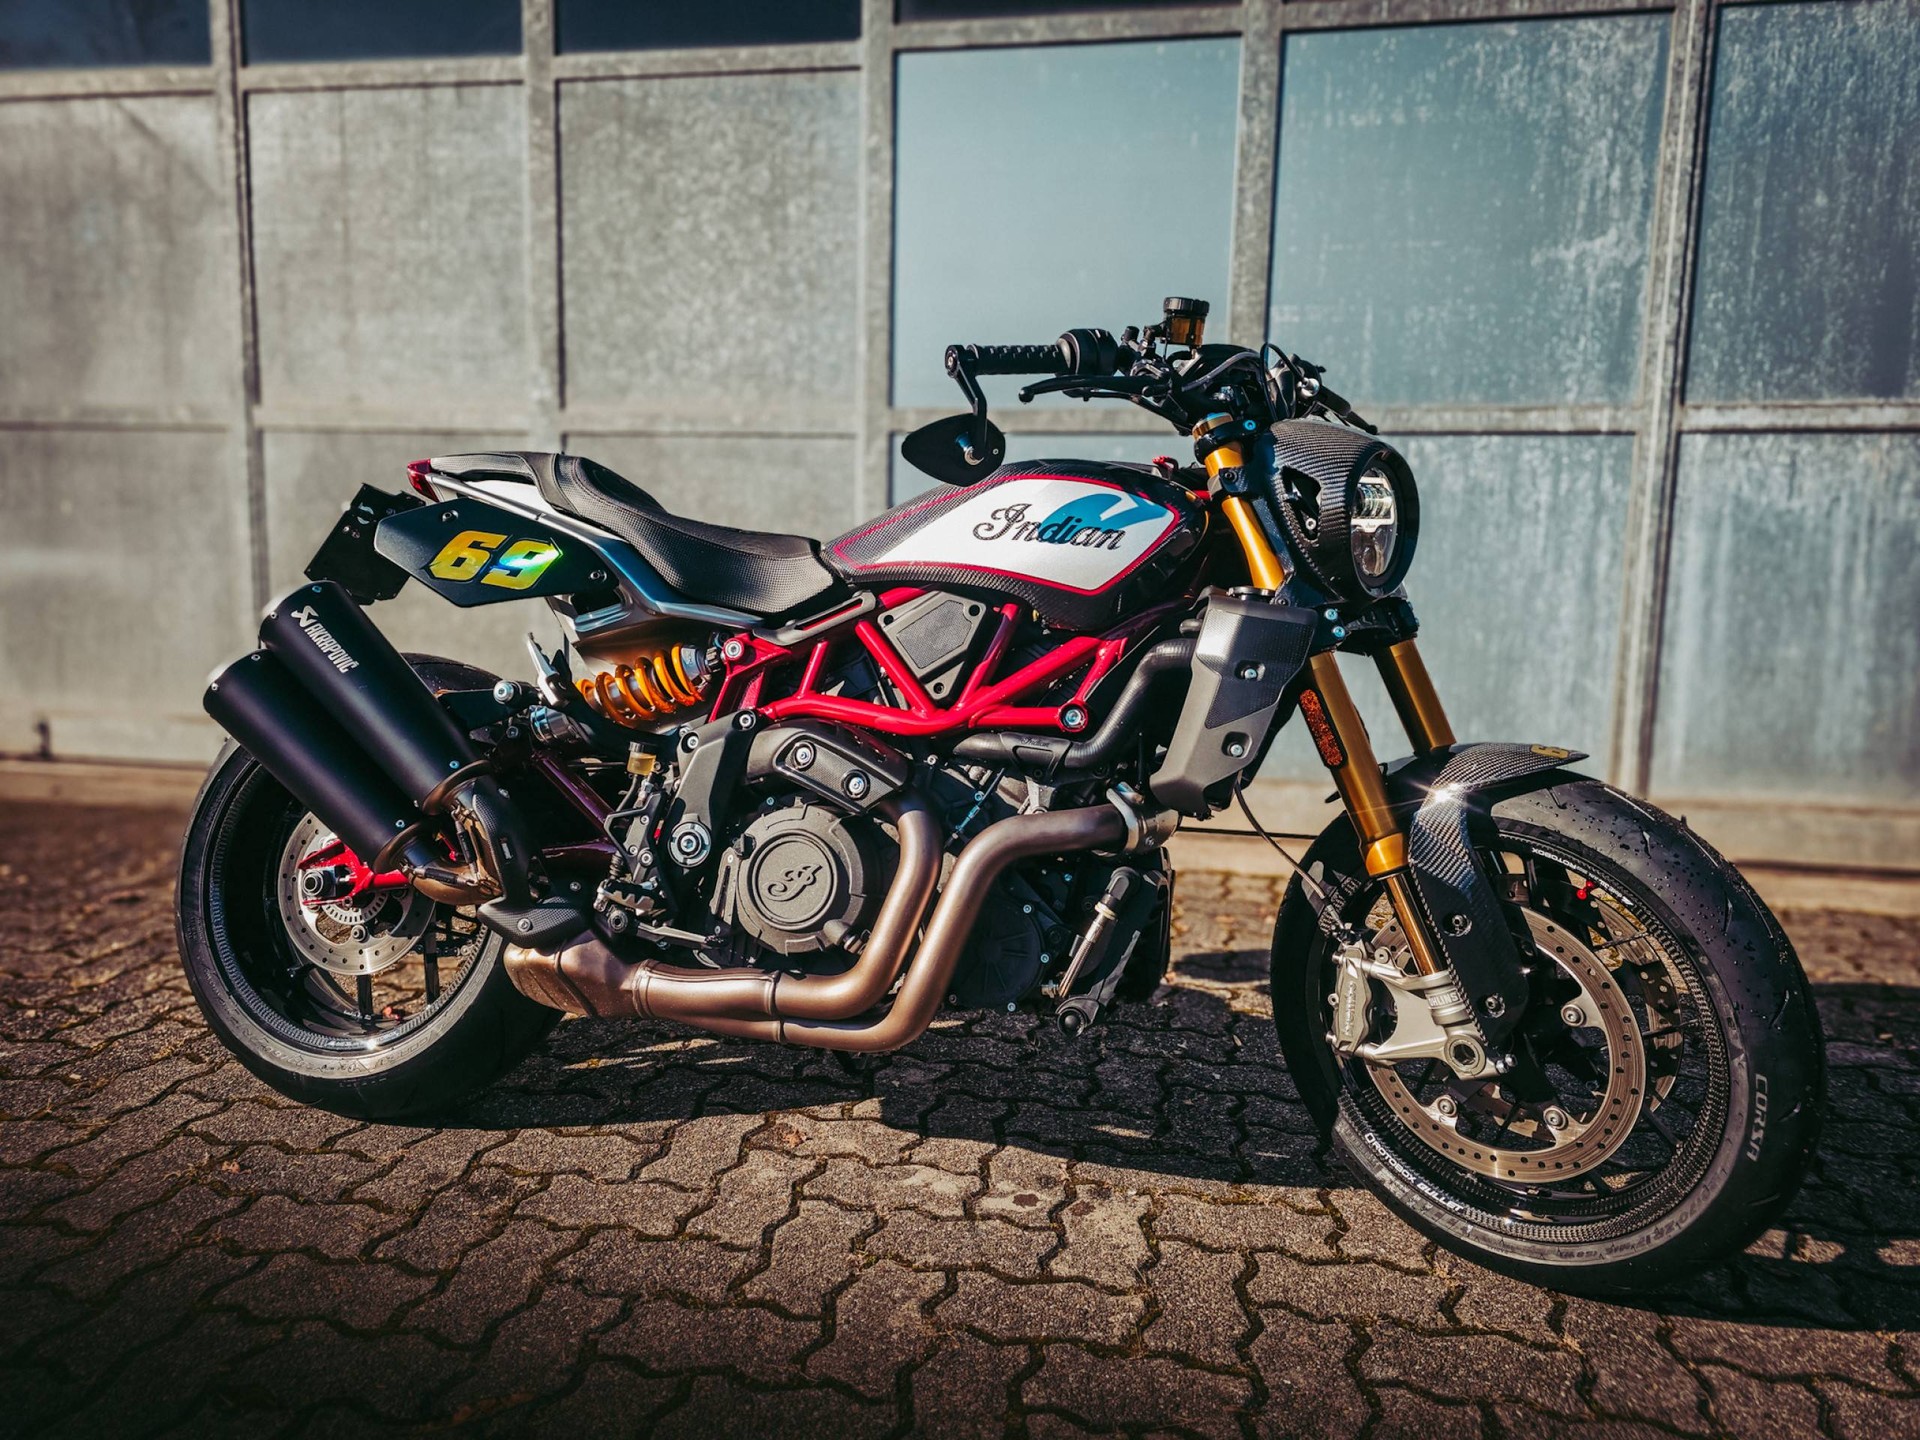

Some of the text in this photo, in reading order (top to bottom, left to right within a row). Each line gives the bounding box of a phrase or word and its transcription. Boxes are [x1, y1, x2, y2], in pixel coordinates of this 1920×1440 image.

[973, 503, 1125, 550] Indian
[429, 530, 561, 590] 69
[1746, 1073, 1768, 1162] CORSA
[1372, 1140, 1464, 1212] ROTOBOX BULLET
